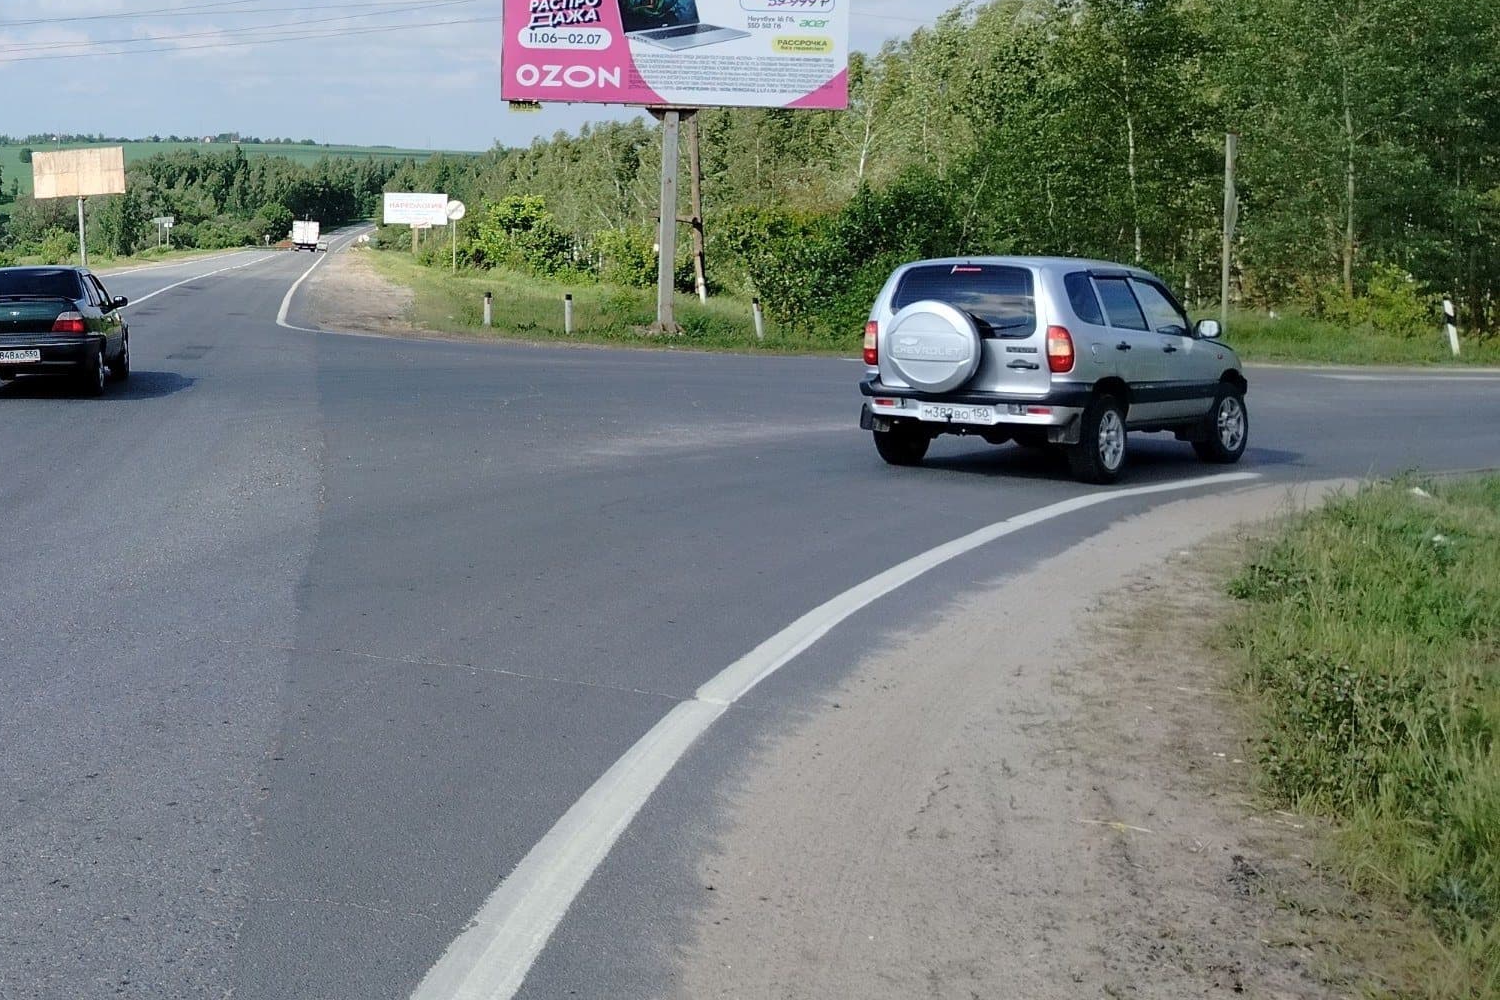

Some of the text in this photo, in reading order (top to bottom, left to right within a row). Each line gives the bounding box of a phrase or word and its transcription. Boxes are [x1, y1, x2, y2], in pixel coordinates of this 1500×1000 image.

[528, 9, 601, 29] ДАЖА
[799, 19, 829, 28] acer
[516, 64, 621, 88] OZON
